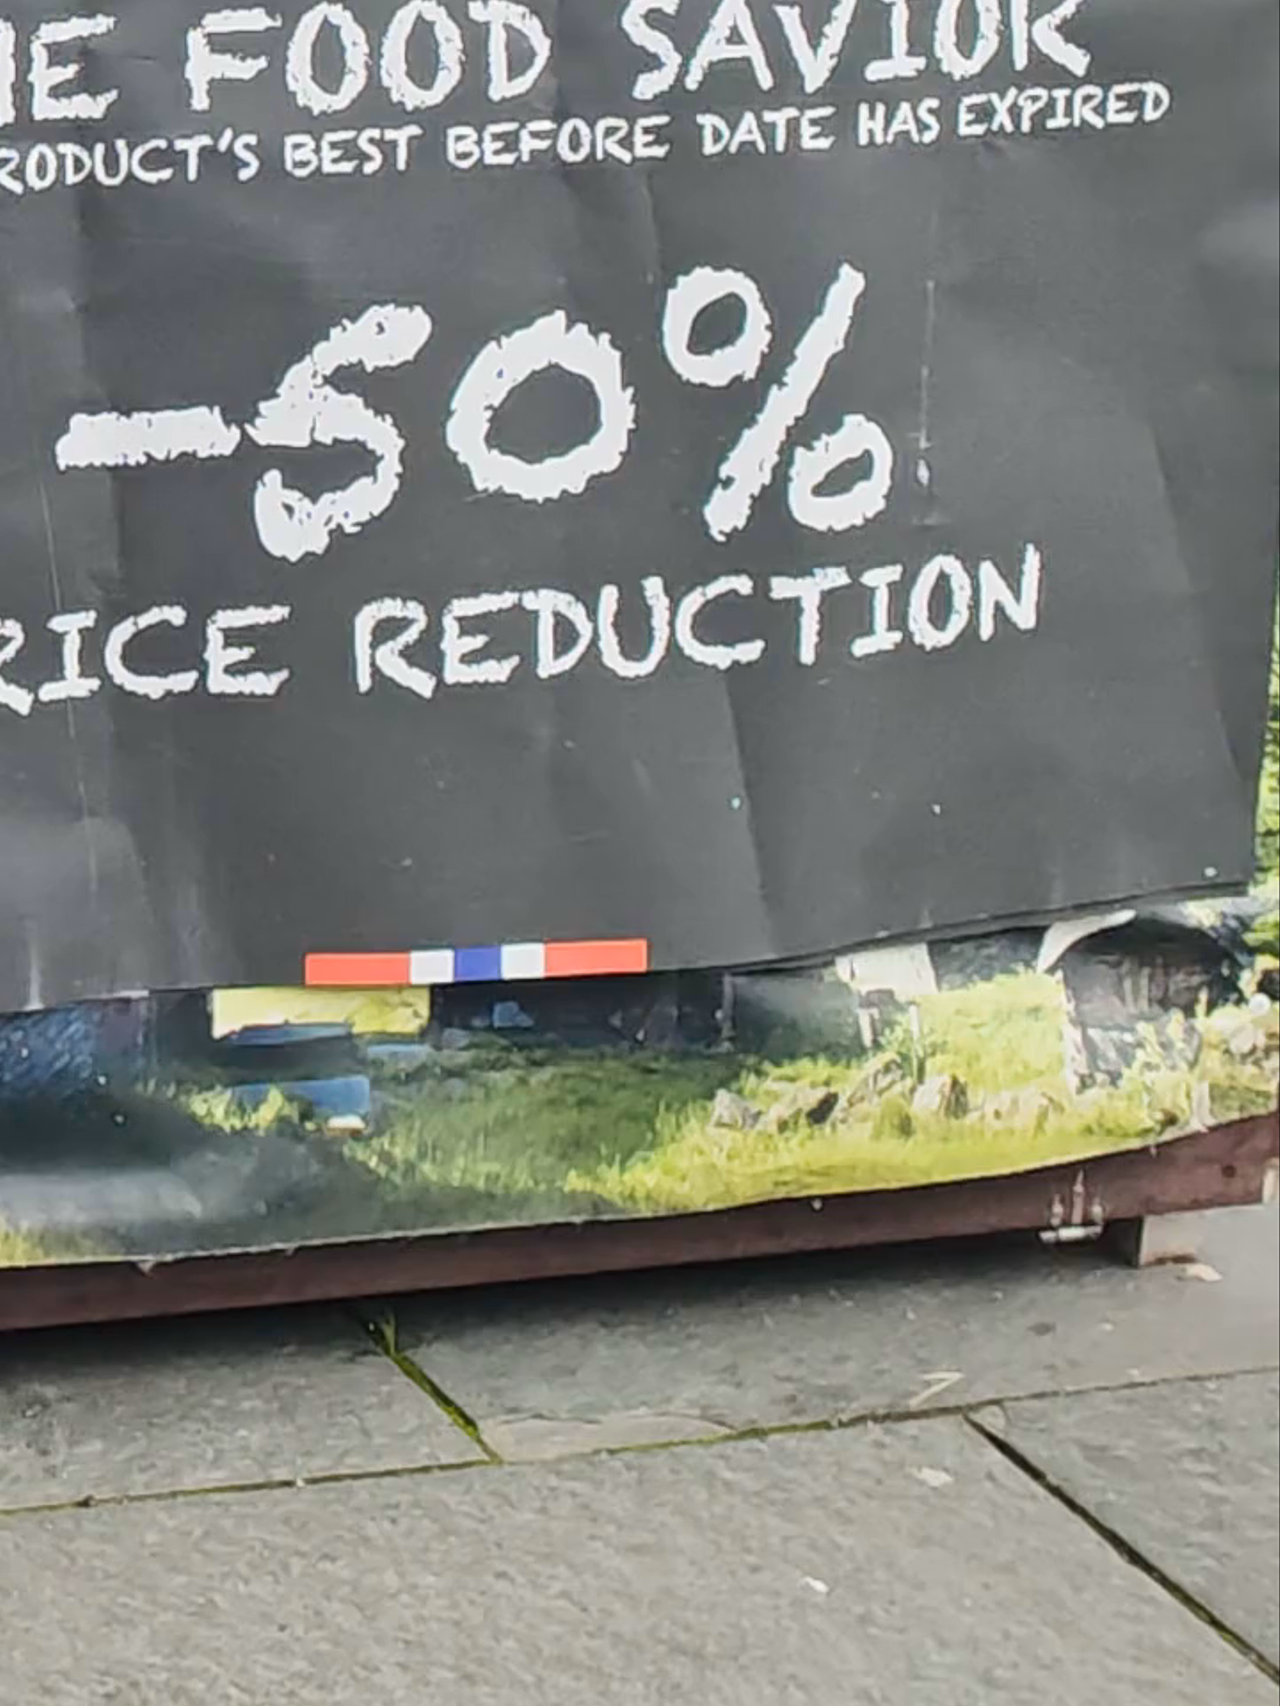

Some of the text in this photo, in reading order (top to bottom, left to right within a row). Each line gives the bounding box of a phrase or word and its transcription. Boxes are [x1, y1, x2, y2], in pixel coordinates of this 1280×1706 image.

[283, 124, 424, 178] BEST
[445, 116, 672, 170] BEFORE
[696, 106, 837, 156] DATE
[857, 97, 942, 146] HAS
[956, 81, 1171, 138] EXPIRED
[54, 262, 894, 563] -50%
[353, 543, 1042, 700] REDUCTION
